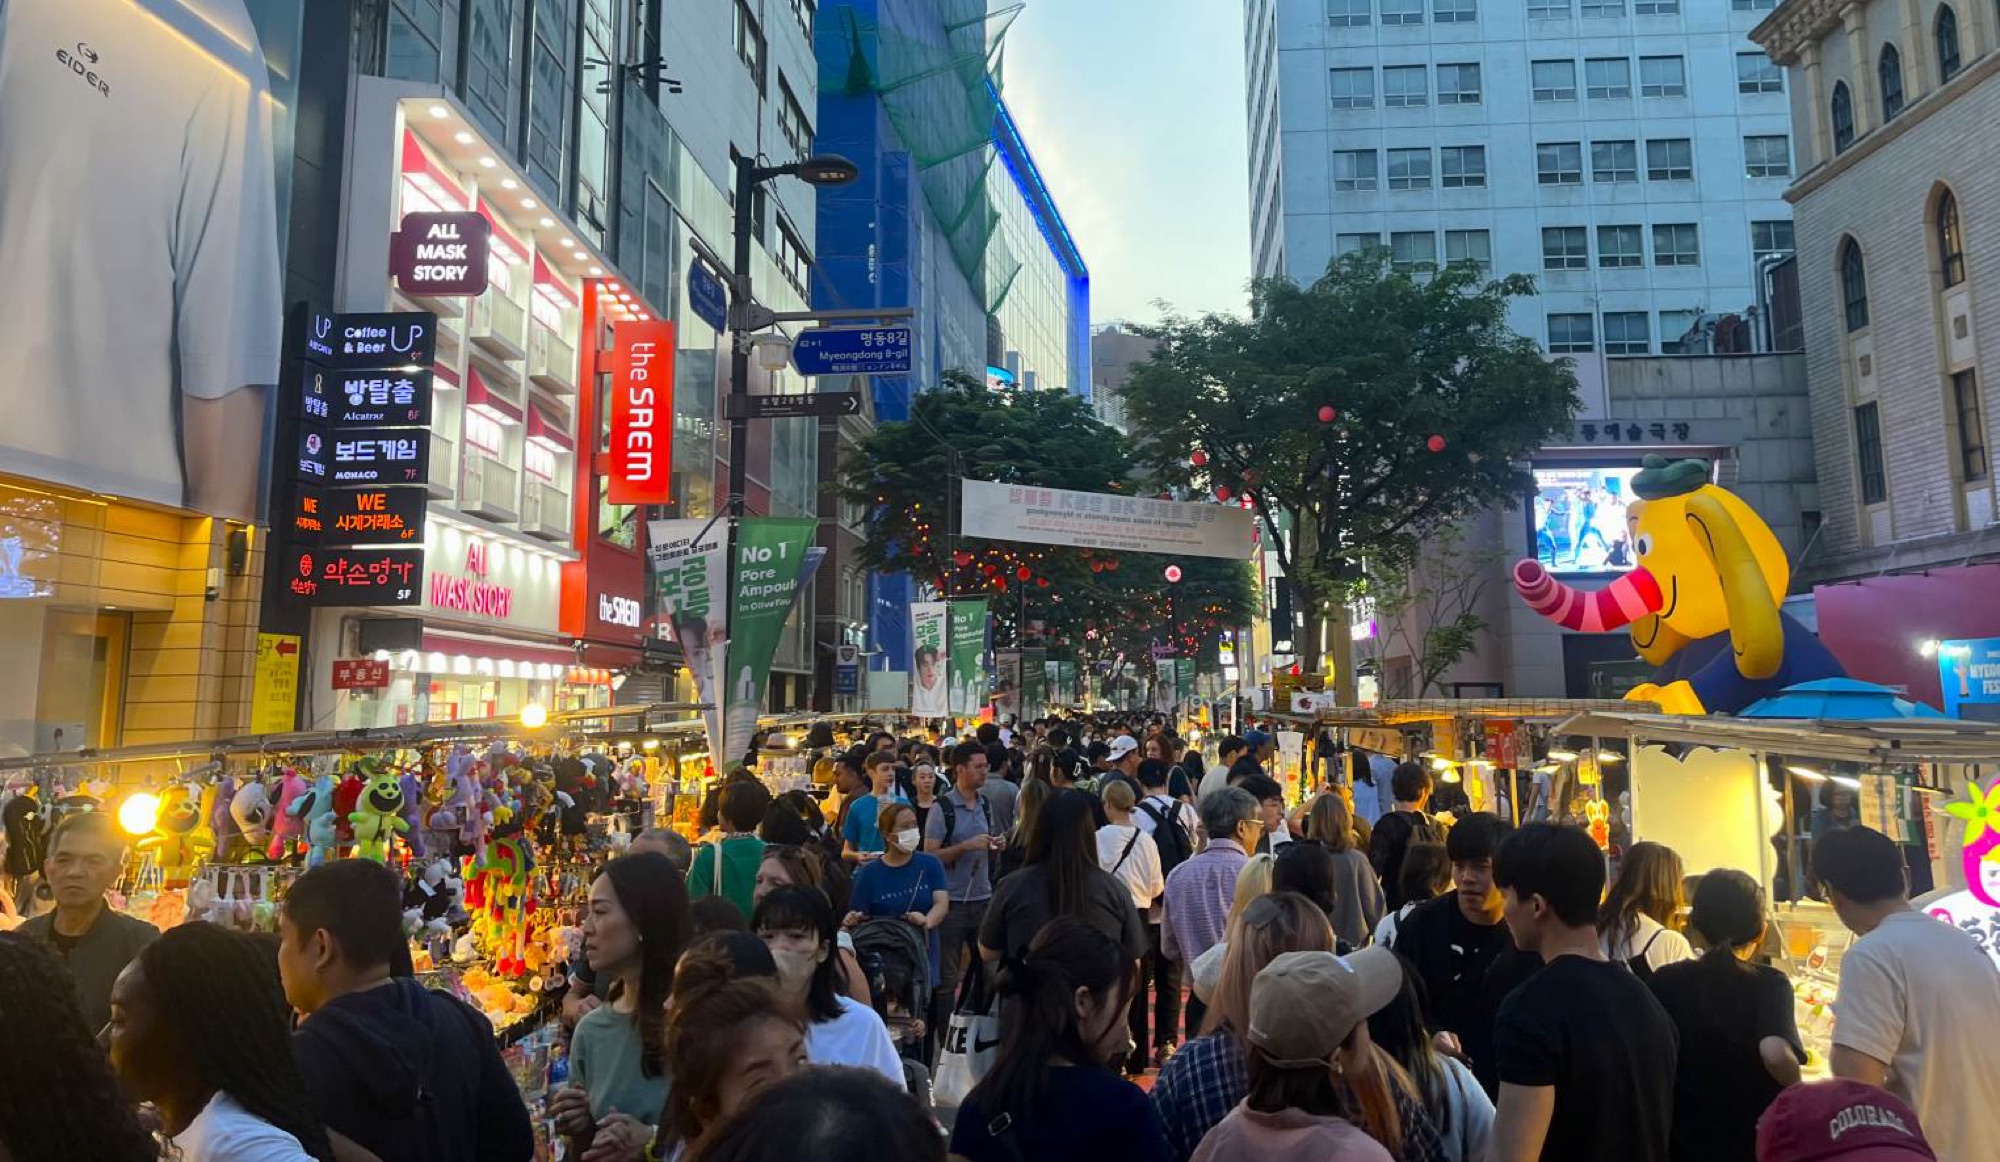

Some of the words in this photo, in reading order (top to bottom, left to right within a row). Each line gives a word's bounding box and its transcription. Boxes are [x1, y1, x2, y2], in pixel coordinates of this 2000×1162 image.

[56, 49, 110, 98] EIDER
[427, 223, 461, 239] ALL
[416, 244, 467, 260] MASK
[413, 265, 468, 281] STORY
[344, 326, 387, 338] Coffee
[860, 331, 908, 347] 명동8길
[344, 342, 354, 354] &
[356, 341, 386, 353] Beer
[819, 350, 883, 361] Myeongdong
[885, 348, 908, 359] 8-gil
[629, 342, 656, 381] the
[344, 378, 415, 406] 방탈출
[343, 412, 384, 421] Alcatraz
[625, 387, 655, 481] SAEM
[1581, 422, 1690, 441] 동예술극장
[335, 439, 417, 461] 보드게임
[335, 471, 378, 480] MONACO
[404, 469, 417, 480] 7F
[303, 497, 318, 514] WE
[356, 494, 388, 511] WE
[335, 514, 404, 531] 시계거래소
[401, 529, 415, 539] 6F
[741, 545, 772, 564] No
[778, 541, 787, 560] 1
[323, 557, 413, 586] 약손명가
[740, 568, 776, 582] Pore
[396, 589, 412, 600] 5F
[431, 571, 471, 611] MASK
[474, 583, 512, 618] STORY
[599, 592, 613, 622] the
[612, 596, 640, 628] SAEM
